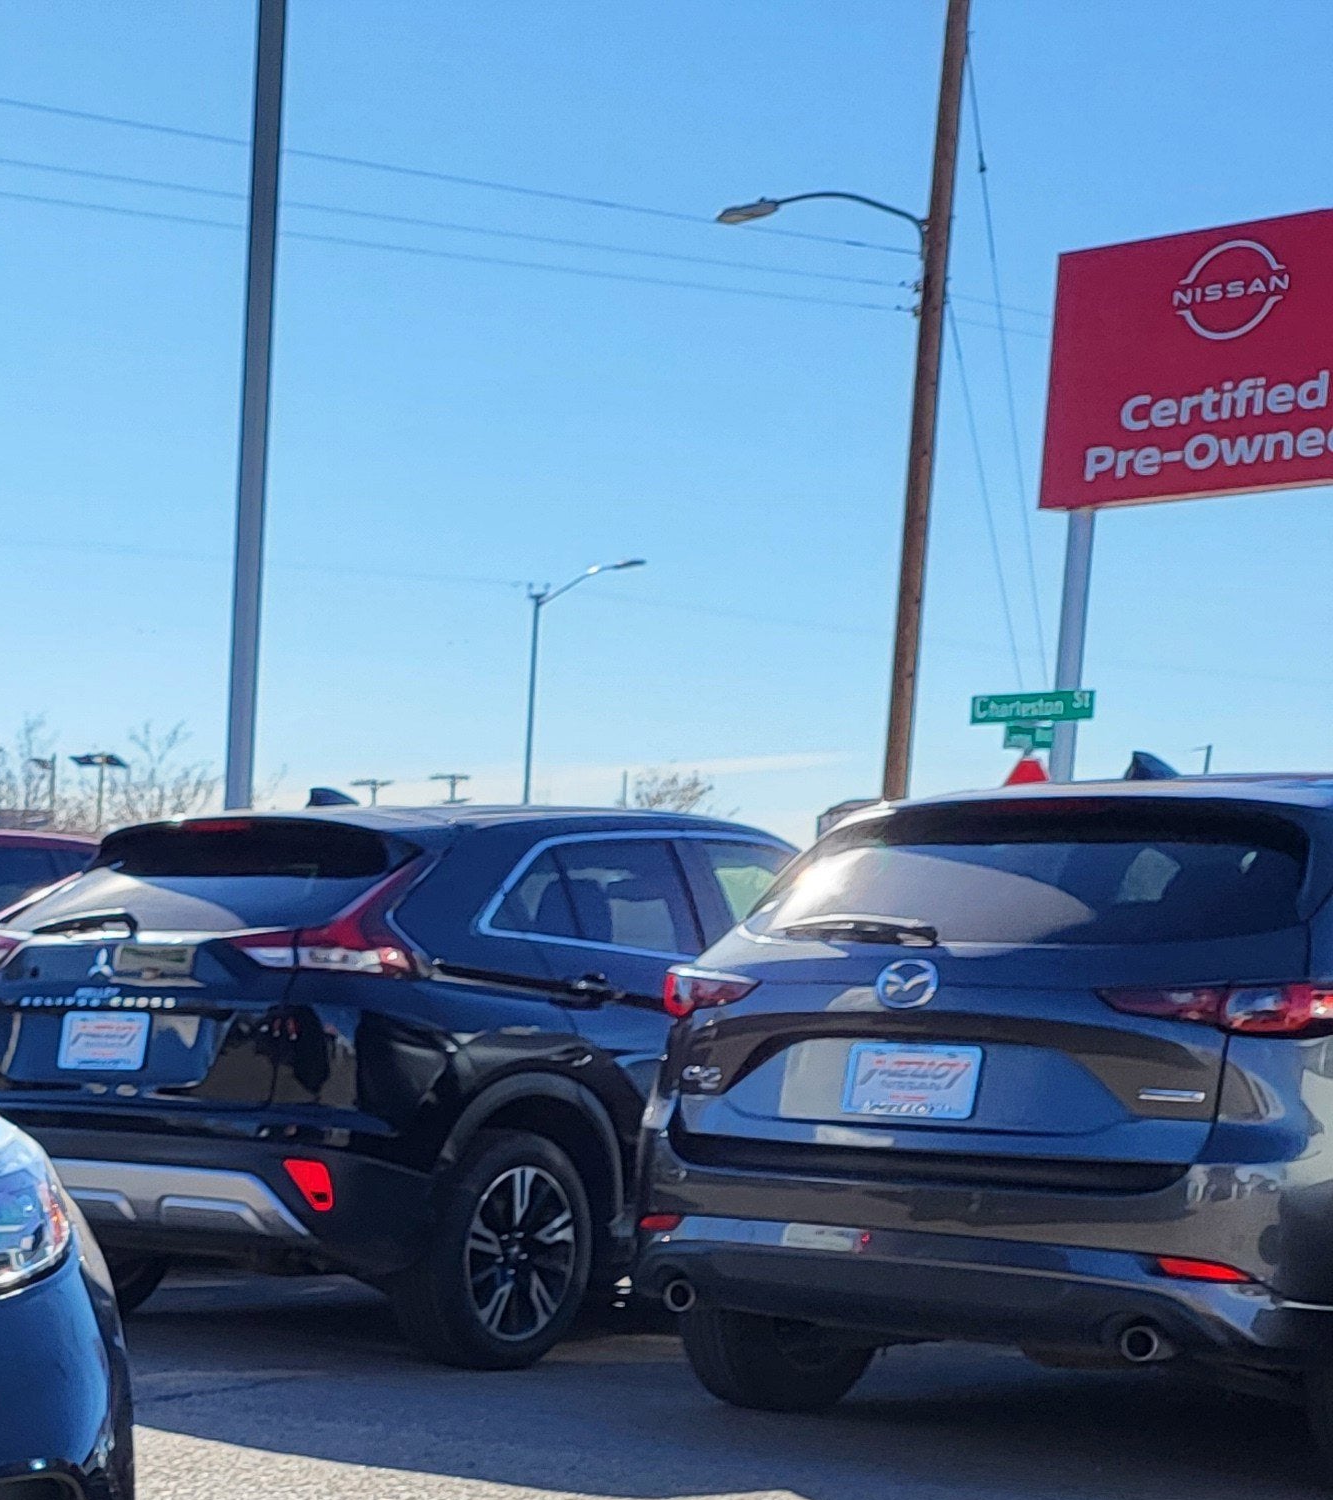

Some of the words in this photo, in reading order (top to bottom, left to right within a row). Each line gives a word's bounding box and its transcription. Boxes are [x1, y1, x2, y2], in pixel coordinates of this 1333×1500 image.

[1172, 273, 1290, 307] NISSAN
[1120, 369, 1331, 432] Certified
[1084, 425, 1333, 482] Pre-Owne
